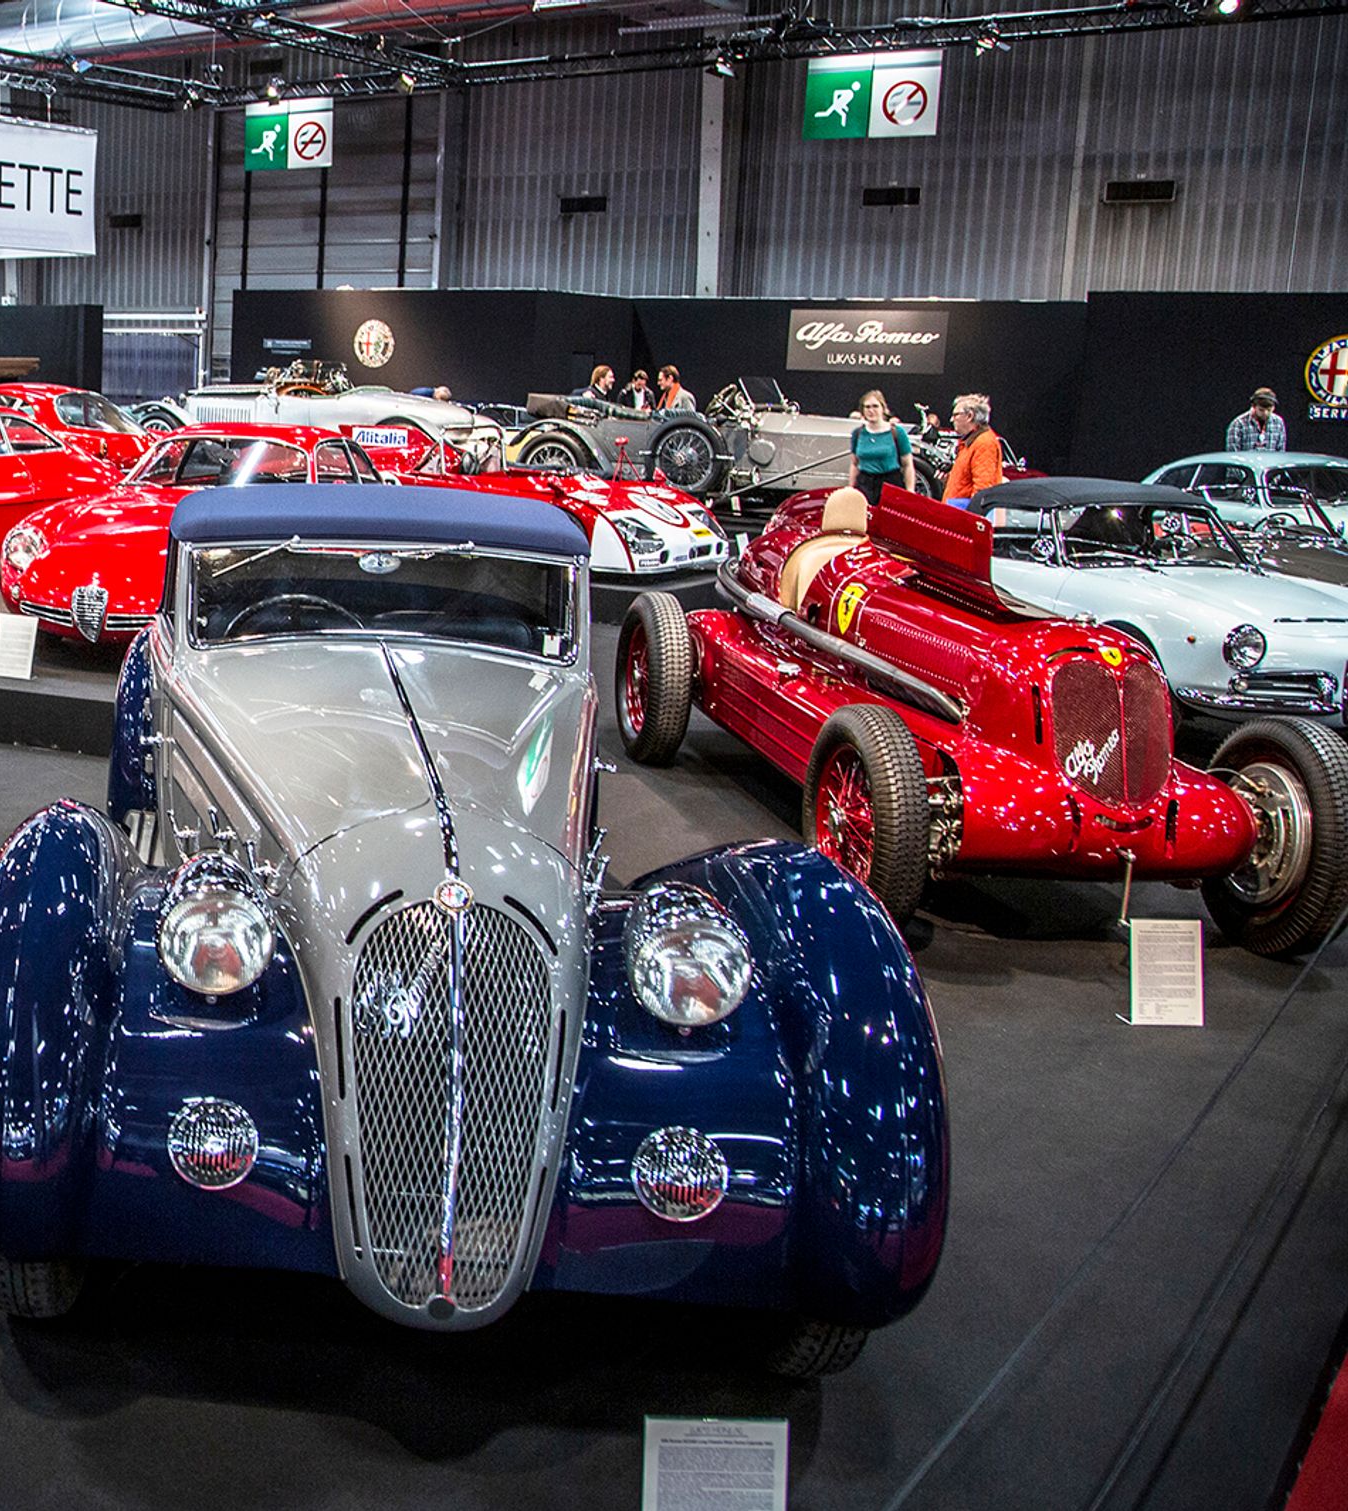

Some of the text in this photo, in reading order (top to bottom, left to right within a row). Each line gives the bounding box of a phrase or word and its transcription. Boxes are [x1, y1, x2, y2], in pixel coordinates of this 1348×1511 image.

[796, 320, 941, 350] Alfa Romeo
[826, 353, 856, 366] LUKAS
[887, 354, 902, 367] AG
[355, 430, 406, 445] Alitalia
